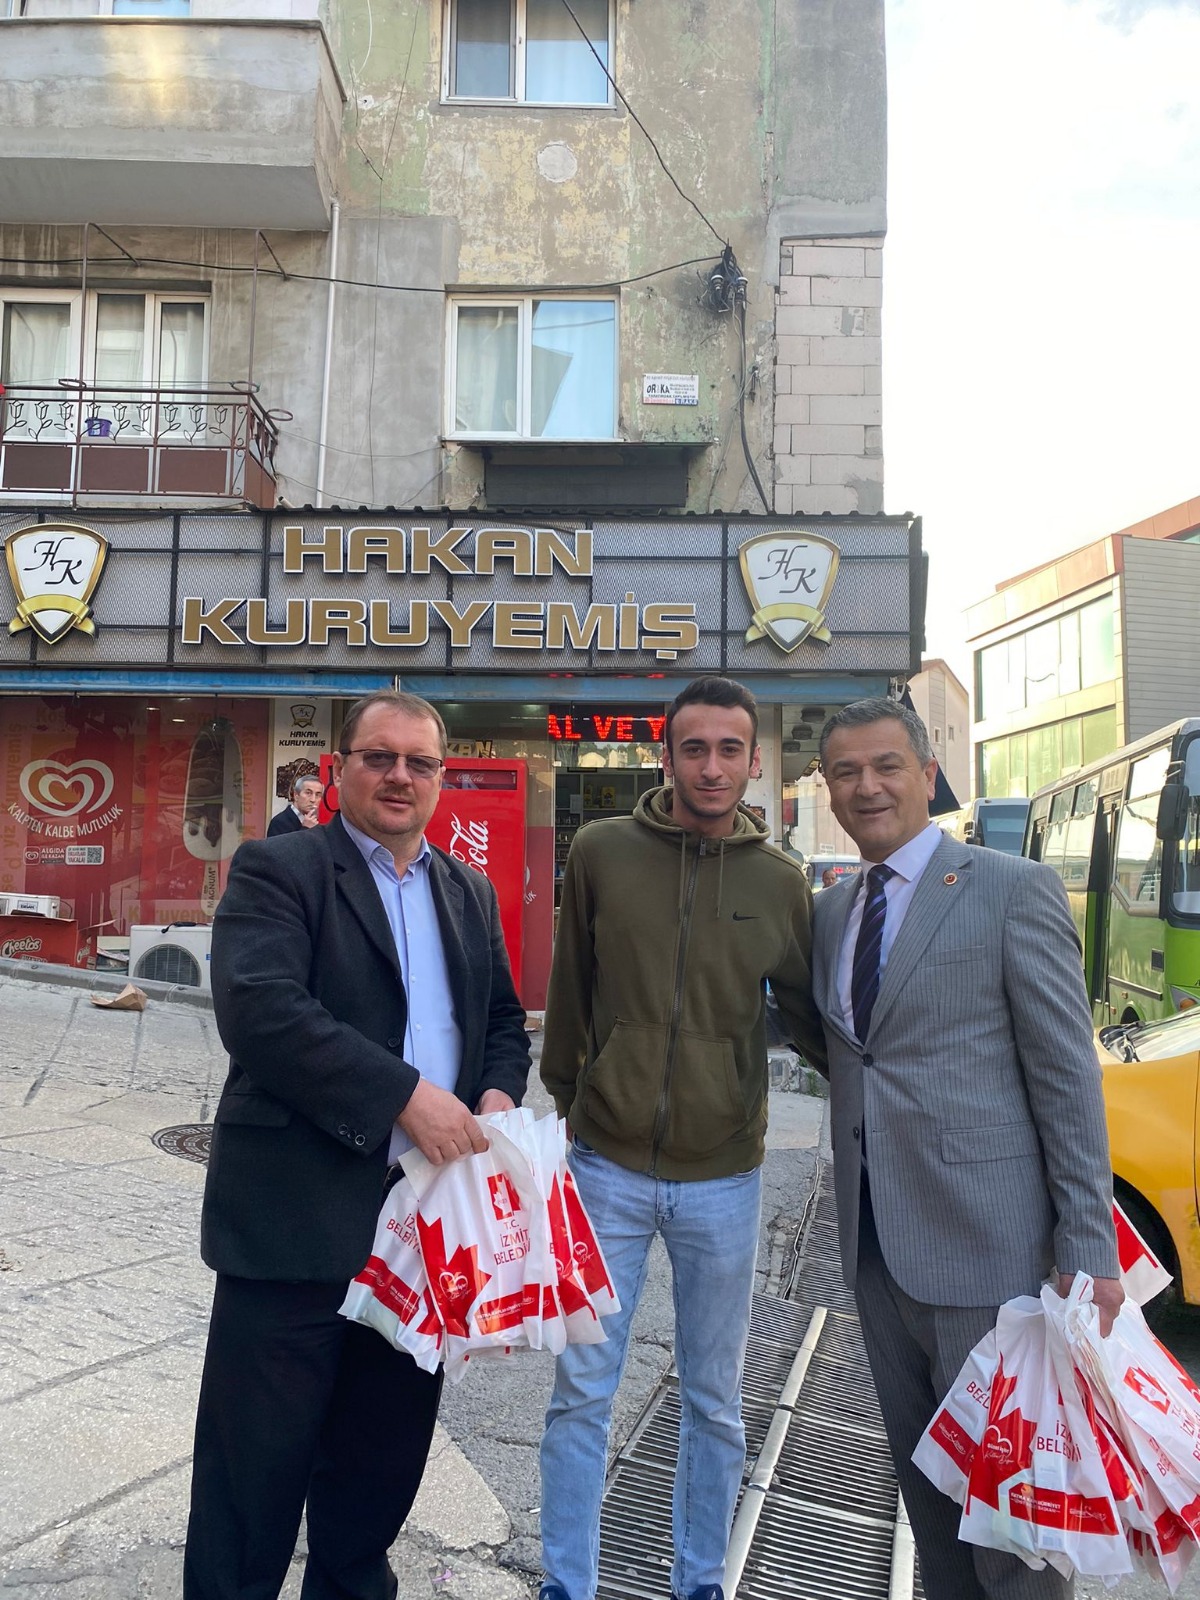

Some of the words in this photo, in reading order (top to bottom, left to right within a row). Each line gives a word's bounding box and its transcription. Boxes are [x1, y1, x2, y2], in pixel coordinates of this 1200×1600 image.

[283, 526, 594, 577] HAKAN
[182, 597, 700, 660] KURUYEMİŞ
[593, 714, 633, 740] VE
[278, 739, 326, 748] KURUYEMİŞ
[7, 803, 44, 834] KALPTEN
[44, 823, 74, 838] KALBE
[76, 804, 124, 837] MUTLULUK
[1, 936, 42, 959] Cheetos
